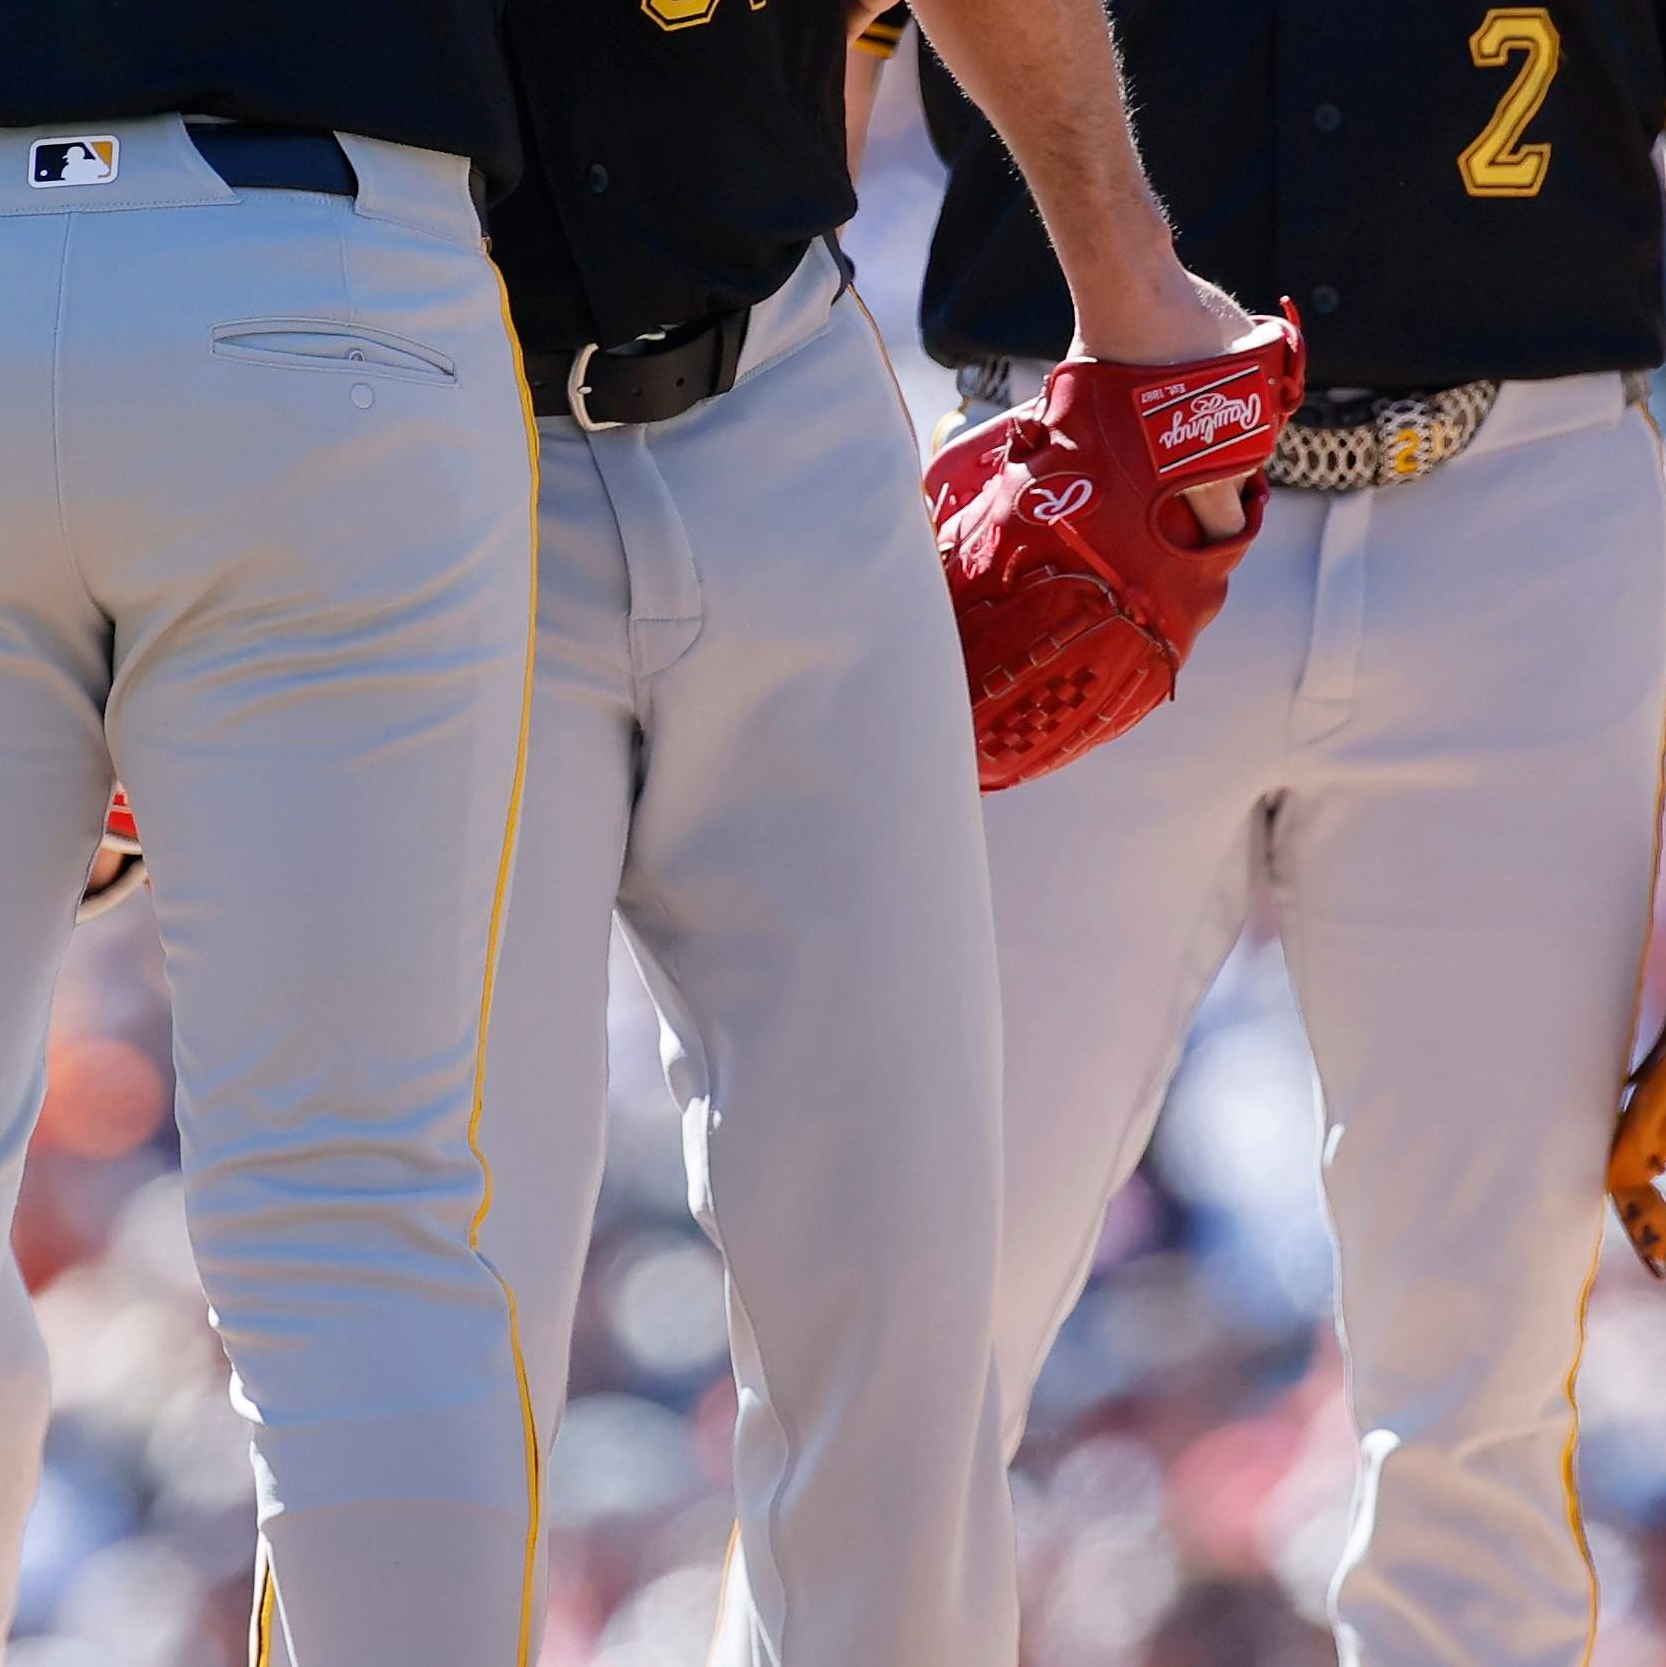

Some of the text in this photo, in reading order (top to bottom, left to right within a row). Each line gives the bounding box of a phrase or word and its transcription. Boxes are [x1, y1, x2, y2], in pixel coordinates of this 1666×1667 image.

[1456, 6, 1561, 198] 2
[1158, 392, 1262, 450] Rawlings
[1395, 428, 1421, 475] 2
